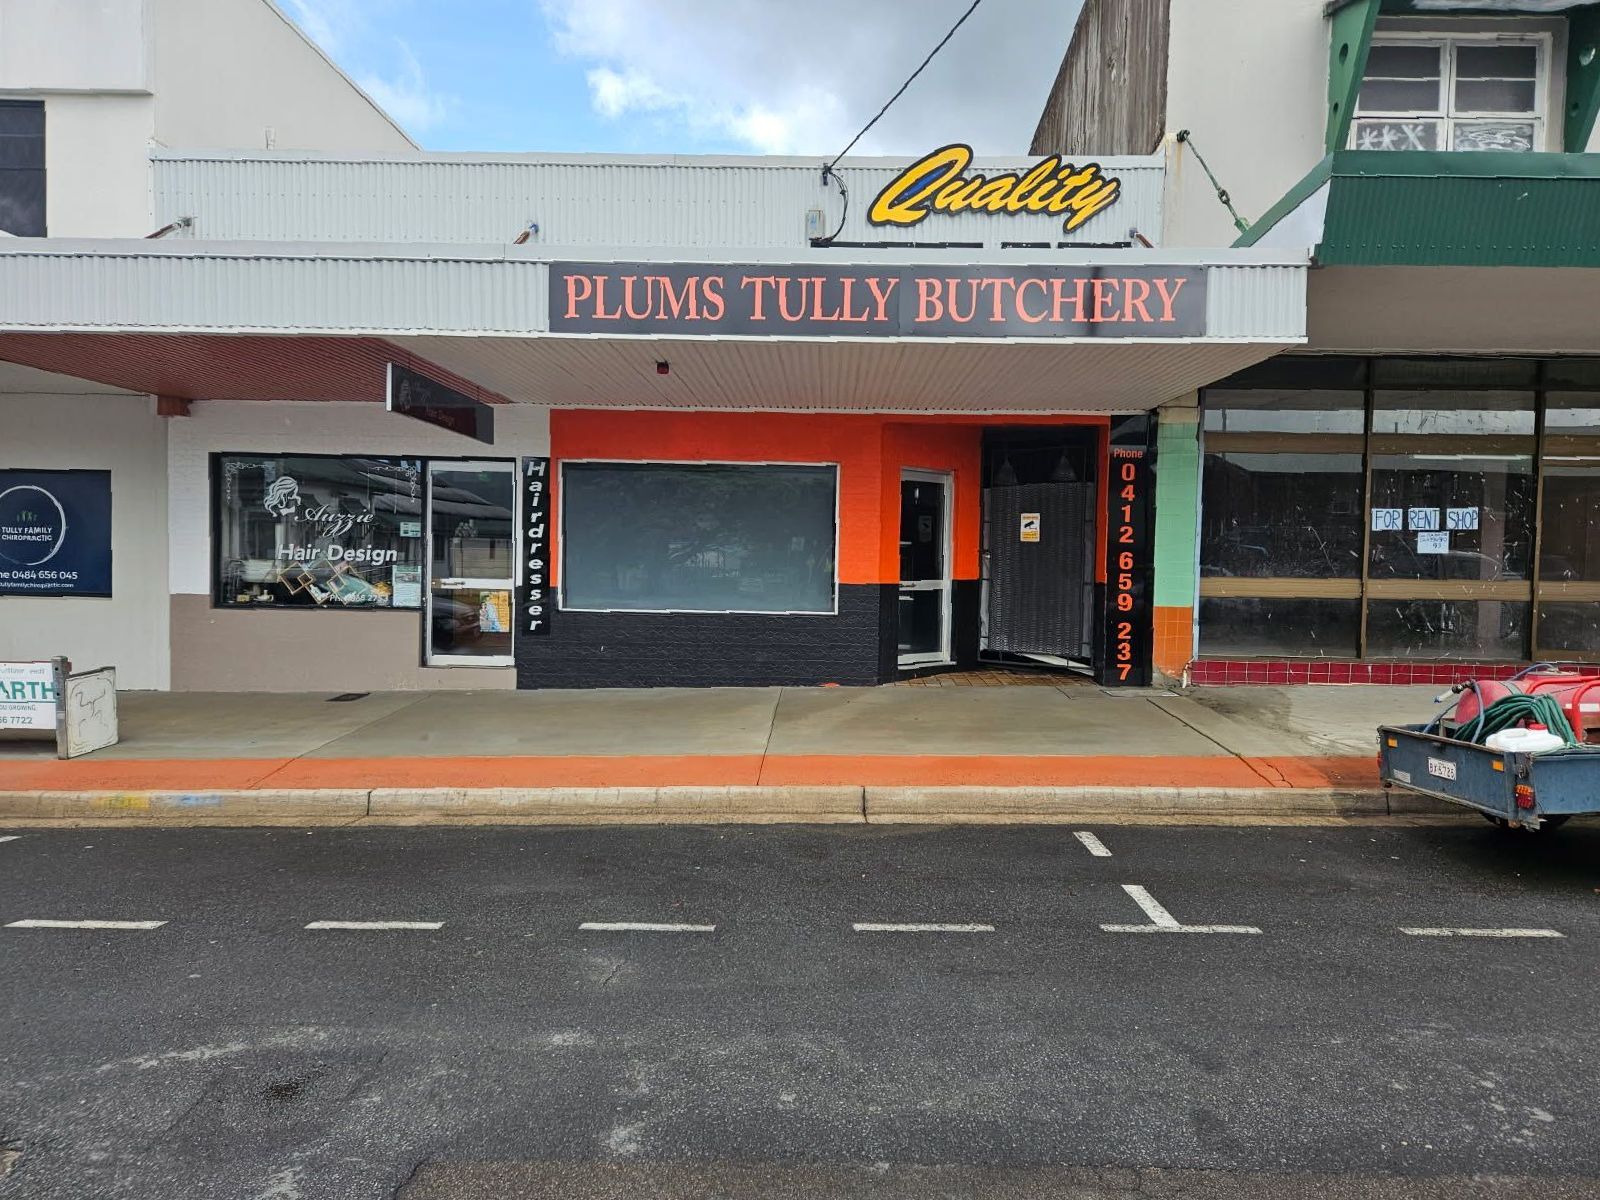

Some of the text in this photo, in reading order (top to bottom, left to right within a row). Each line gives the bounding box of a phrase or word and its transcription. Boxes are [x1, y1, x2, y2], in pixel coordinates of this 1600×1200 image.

[868, 143, 1121, 234] Quality
[562, 275, 1188, 323] PLUMS TULLY BUTCHERY
[1113, 447, 1143, 459] Phone
[1375, 509, 1478, 529] FOR RENT SHOP
[1, 526, 52, 534] TULLY FAMILY
[277, 544, 398, 566] Hair Design
[526, 461, 546, 631] Hairdresser
[12, 570, 36, 579] 0484
[38, 570, 57, 579] 656
[59, 571, 78, 580] 045
[10, 716, 33, 724] 7722
